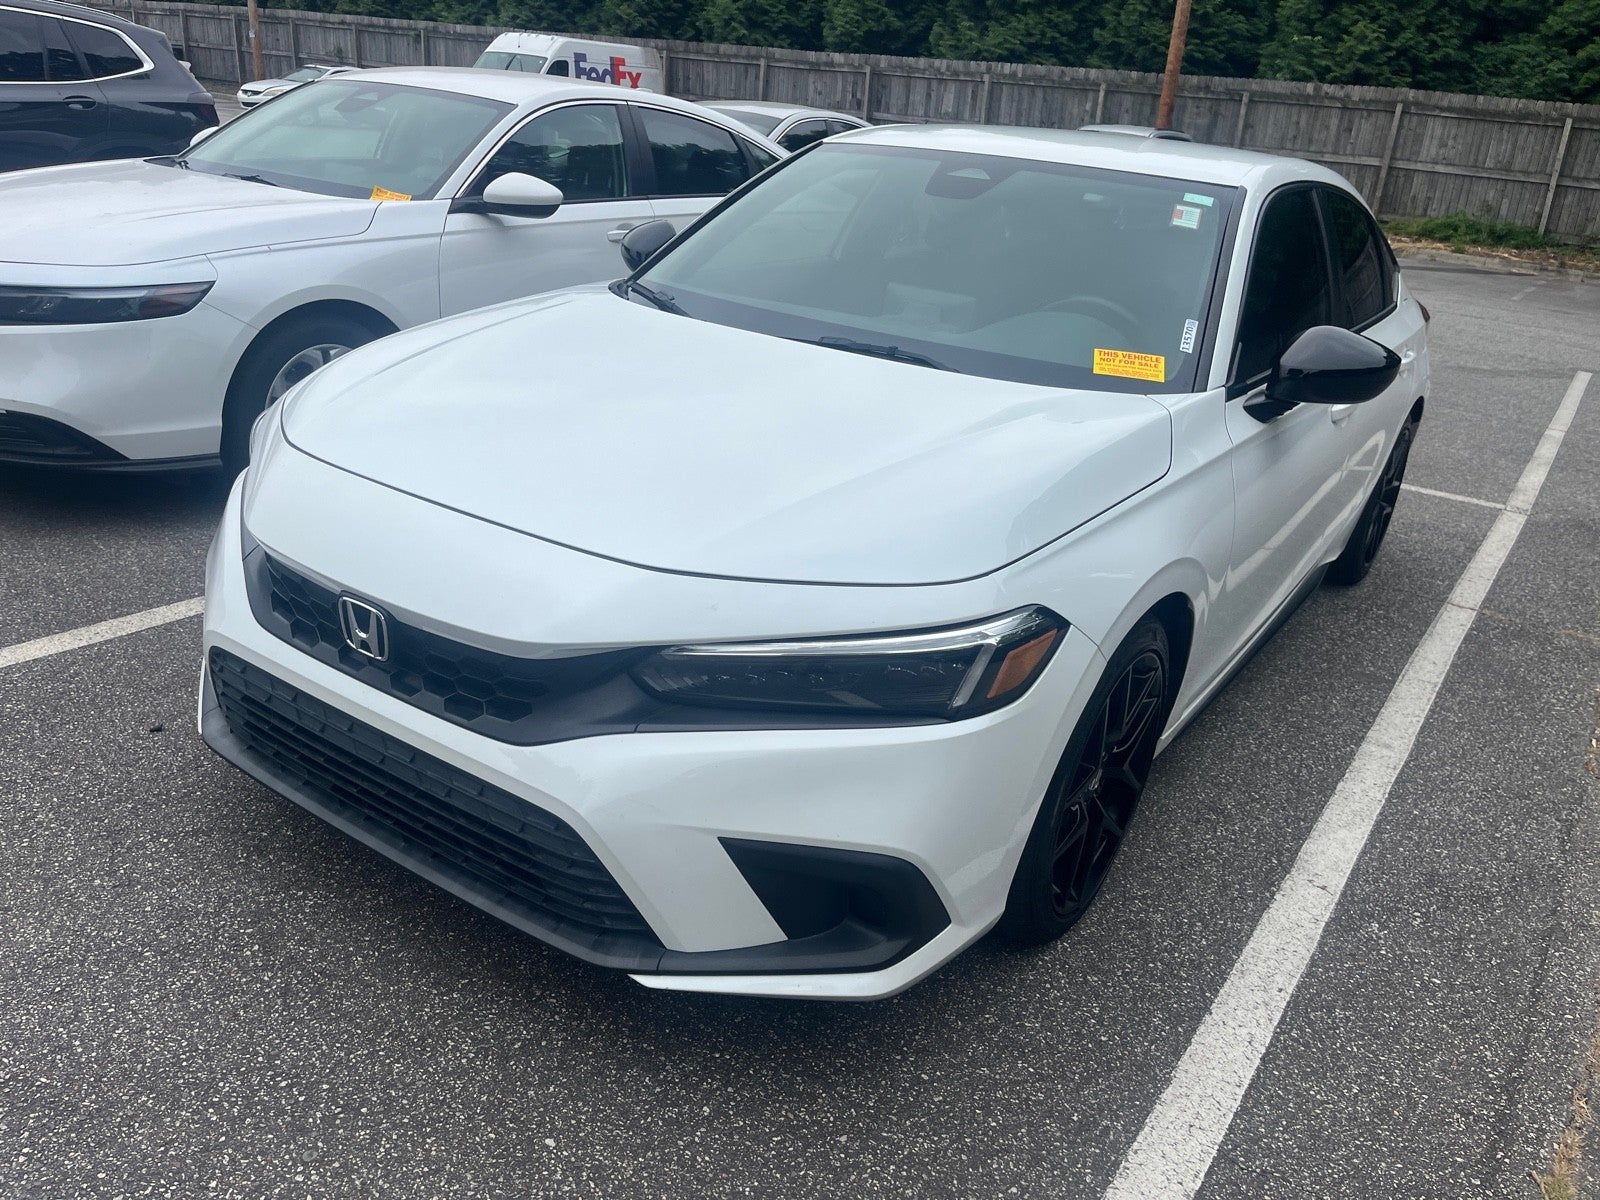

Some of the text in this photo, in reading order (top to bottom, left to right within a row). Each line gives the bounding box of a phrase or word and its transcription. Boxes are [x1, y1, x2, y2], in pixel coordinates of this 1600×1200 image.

[574, 52, 641, 88] FedEx
[1182, 326, 1194, 351] 13570
[1098, 350, 1162, 364] THIS VEHICLE
[1138, 361, 1160, 369] SALE
